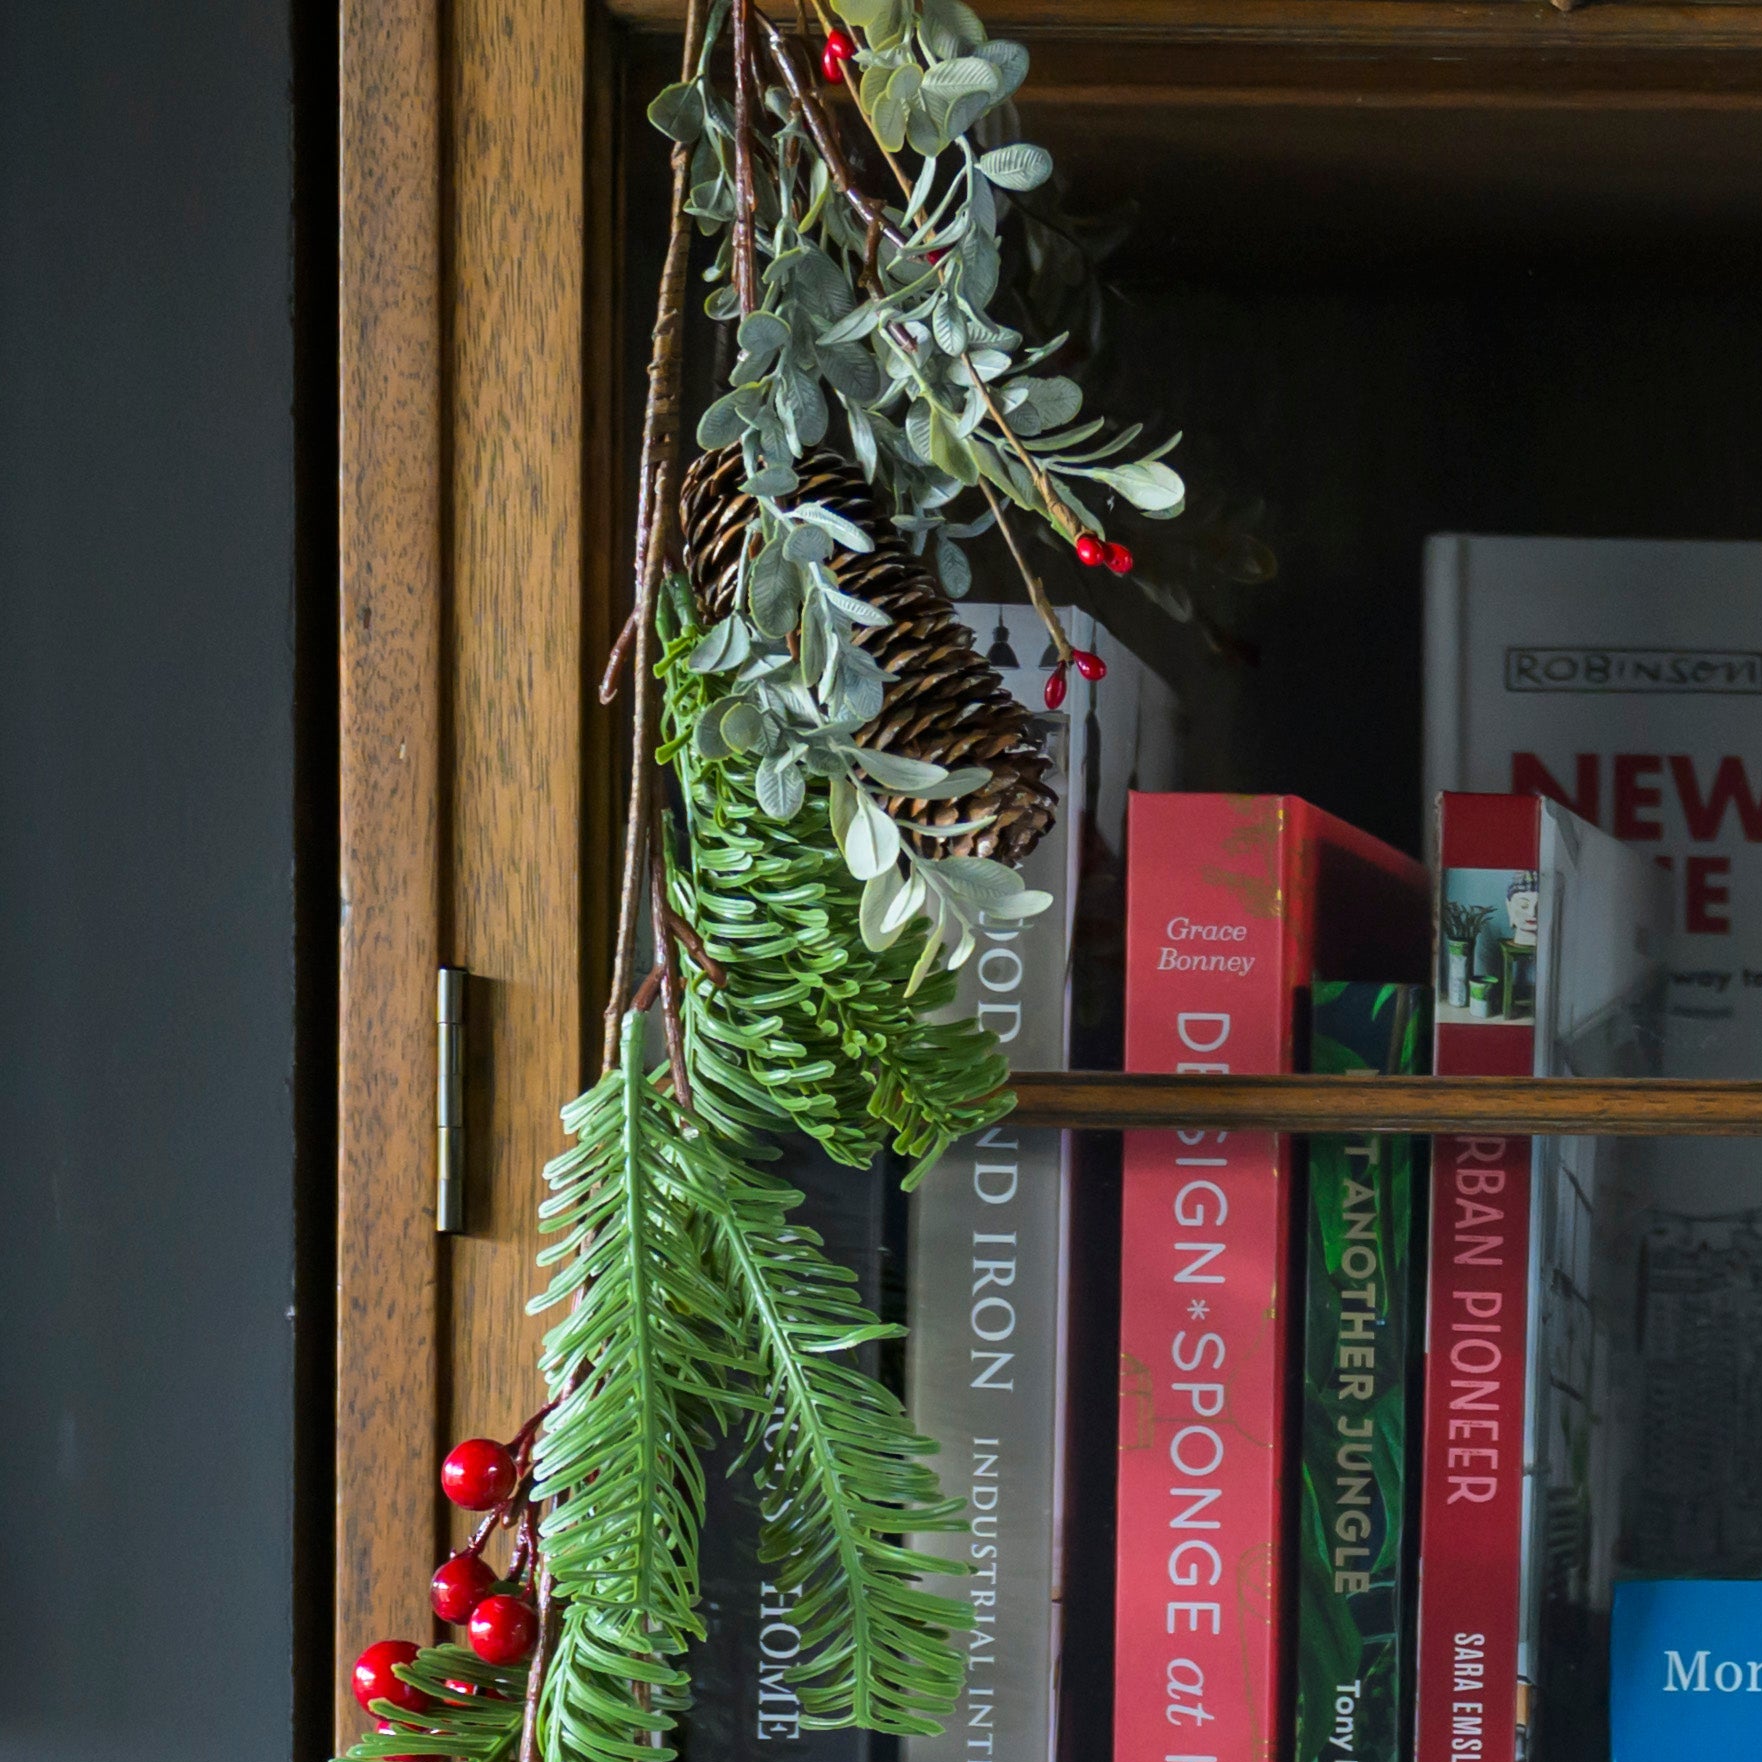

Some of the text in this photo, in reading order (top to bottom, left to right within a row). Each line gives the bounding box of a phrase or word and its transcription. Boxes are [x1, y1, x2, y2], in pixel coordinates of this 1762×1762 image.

[1157, 947, 1255, 976] Bonney
[1166, 916, 1248, 942] Grace
[969, 1231, 1018, 1393] IRON
[1338, 1177, 1378, 1400] ANOTHER
[1446, 1135, 1507, 1505] RBAN PIONEER
[967, 1437, 1000, 1672] INDUSTRIAL
[1334, 1416, 1374, 1594] JUNGLE
[757, 1580, 803, 1740] HOME
[1166, 1657, 1215, 1727] at
[1329, 1680, 1362, 1752] Tony
[1453, 1632, 1486, 1692] SARA
